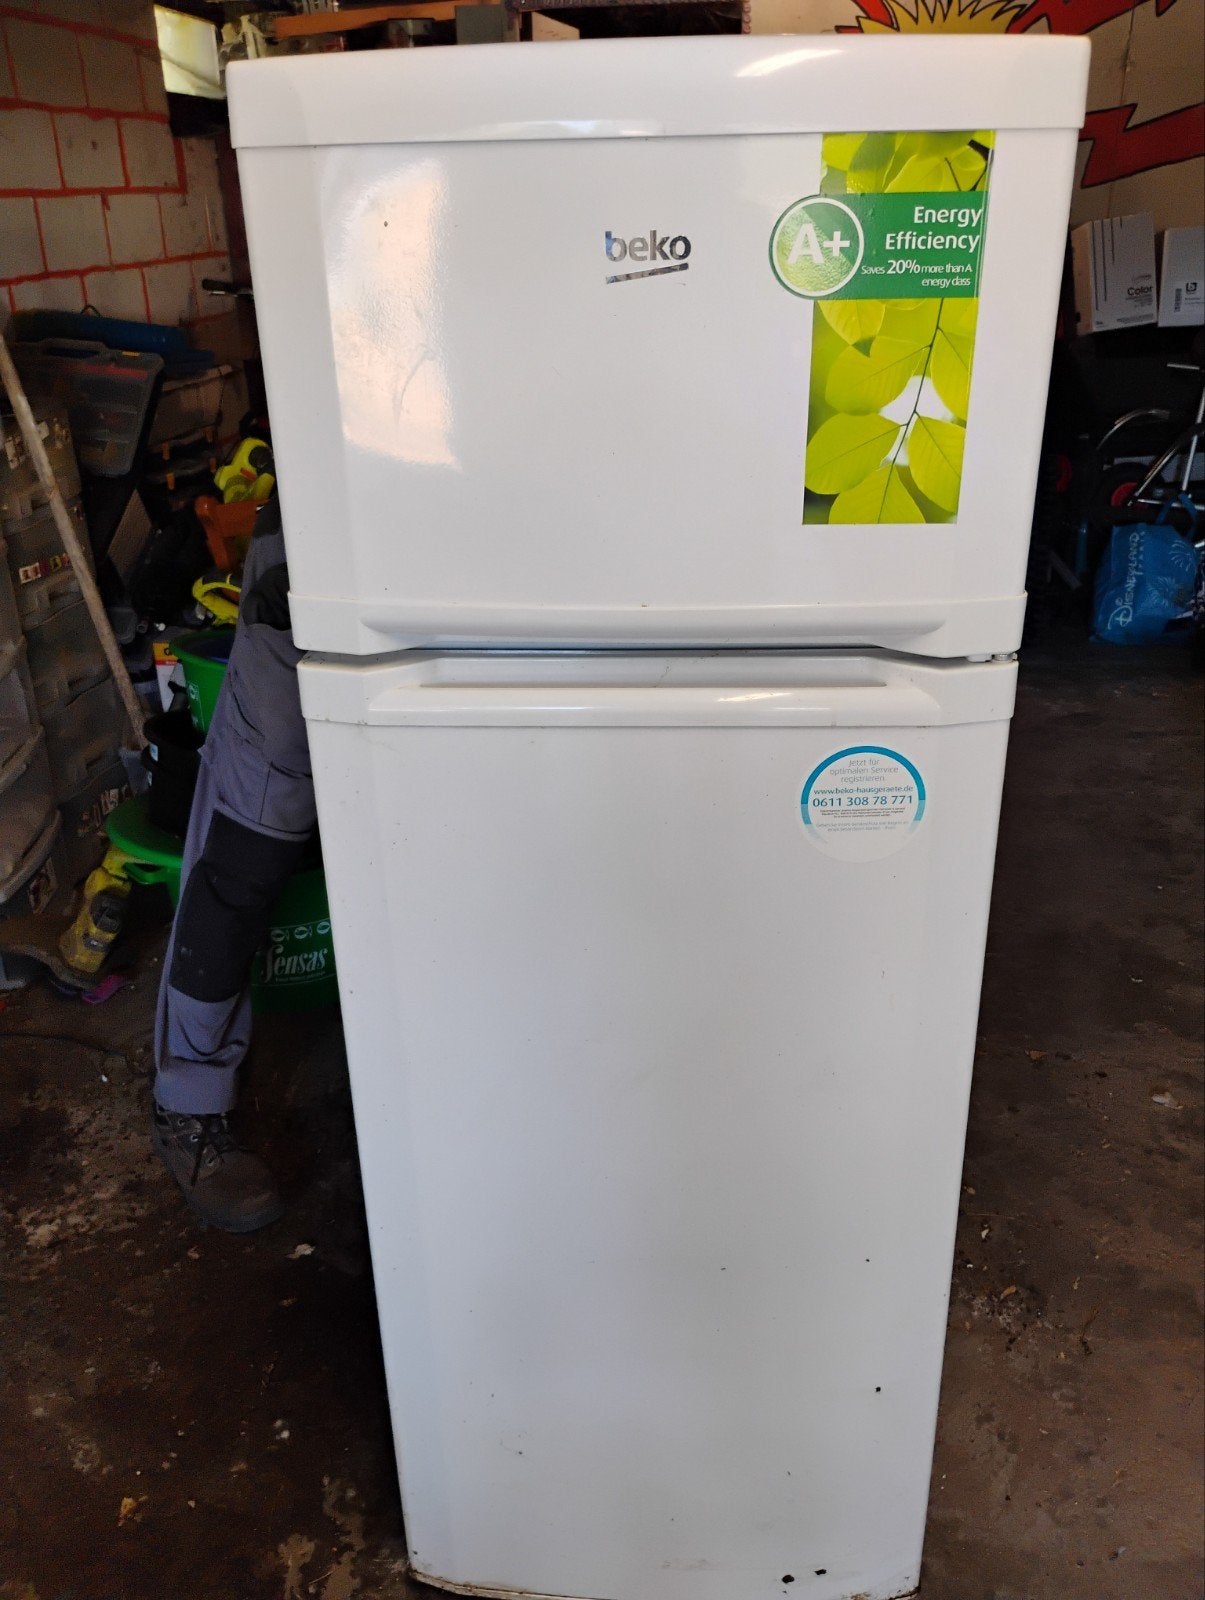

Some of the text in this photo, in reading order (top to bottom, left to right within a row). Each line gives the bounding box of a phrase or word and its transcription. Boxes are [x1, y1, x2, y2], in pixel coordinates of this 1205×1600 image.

[914, 206, 983, 227] Energy
[605, 230, 692, 262] beko
[787, 223, 851, 265] A+
[885, 231, 980, 253] Efficiency
[861, 259, 973, 275] Saves 20% more than A
[921, 276, 971, 289] energy class
[1127, 286, 1153, 295] Color
[848, 758, 880, 767] Jetzt für
[830, 766, 899, 776] optimalen Service
[840, 775, 885, 784] registrieren
[813, 785, 914, 795] www.beko-hausgeraete.de
[812, 795, 913, 807] 0611 308 78 771
[260, 944, 328, 983] Sensas
